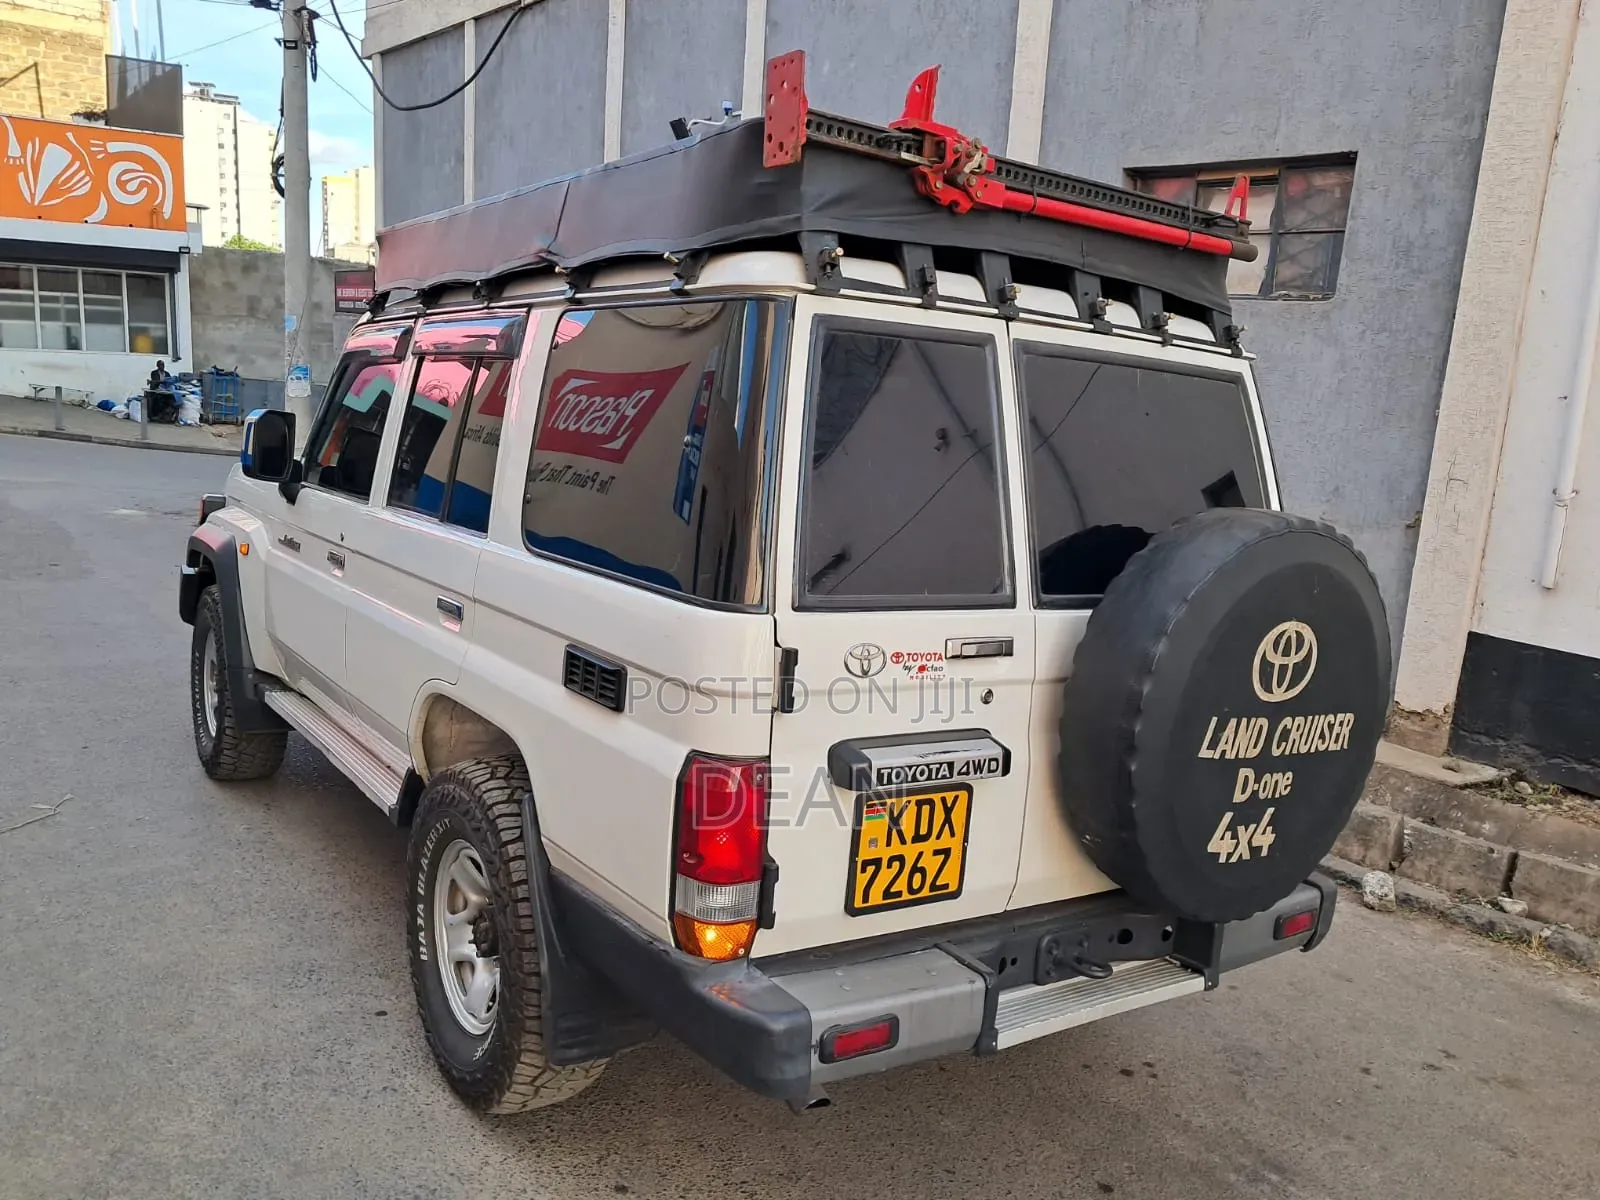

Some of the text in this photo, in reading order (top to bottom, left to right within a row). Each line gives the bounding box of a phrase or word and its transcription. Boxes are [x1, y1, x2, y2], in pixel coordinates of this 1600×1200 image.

[903, 660, 915, 675] by
[906, 652, 944, 662] TOYOTA
[1198, 712, 1355, 760] LAND CRUISER
[880, 757, 1000, 785] TOYOTA 4WD
[1232, 767, 1294, 804] D-one
[885, 794, 960, 848] KDX
[1207, 806, 1277, 864] 4x4
[417, 829, 437, 896] BLAZER
[860, 846, 953, 905] 726Z
[416, 903, 428, 961] BAJA
